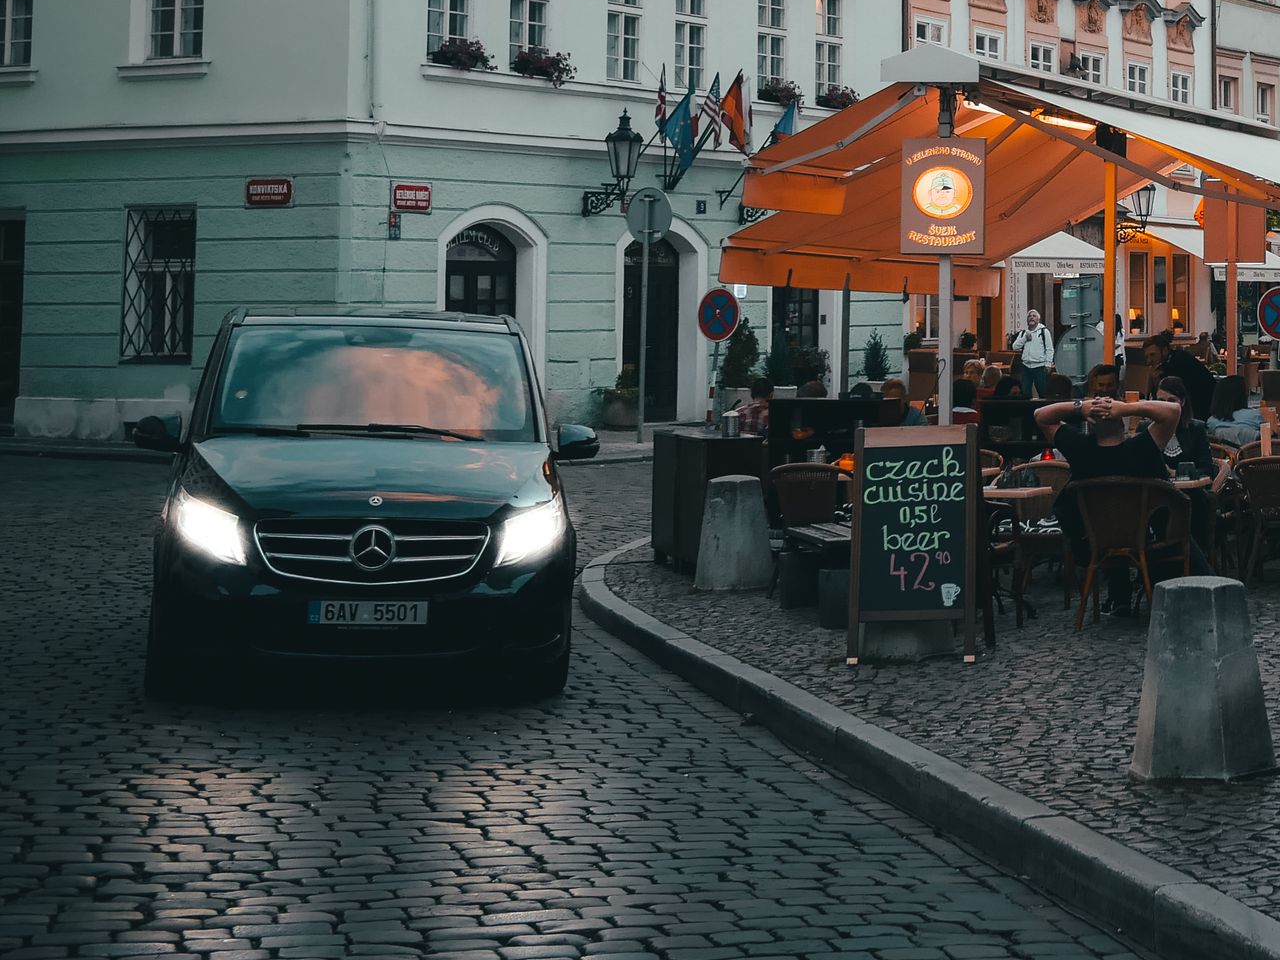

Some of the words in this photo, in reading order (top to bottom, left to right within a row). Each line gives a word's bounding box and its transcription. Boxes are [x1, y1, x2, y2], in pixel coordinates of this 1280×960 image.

[905, 158, 912, 166] U
[951, 147, 982, 166] STROMU
[908, 230, 976, 247] RESTAURANT
[866, 446, 965, 481] czech
[864, 478, 965, 504] cuisine
[881, 525, 950, 551] beer
[325, 603, 359, 621] 6AV
[374, 603, 418, 622] 5501
